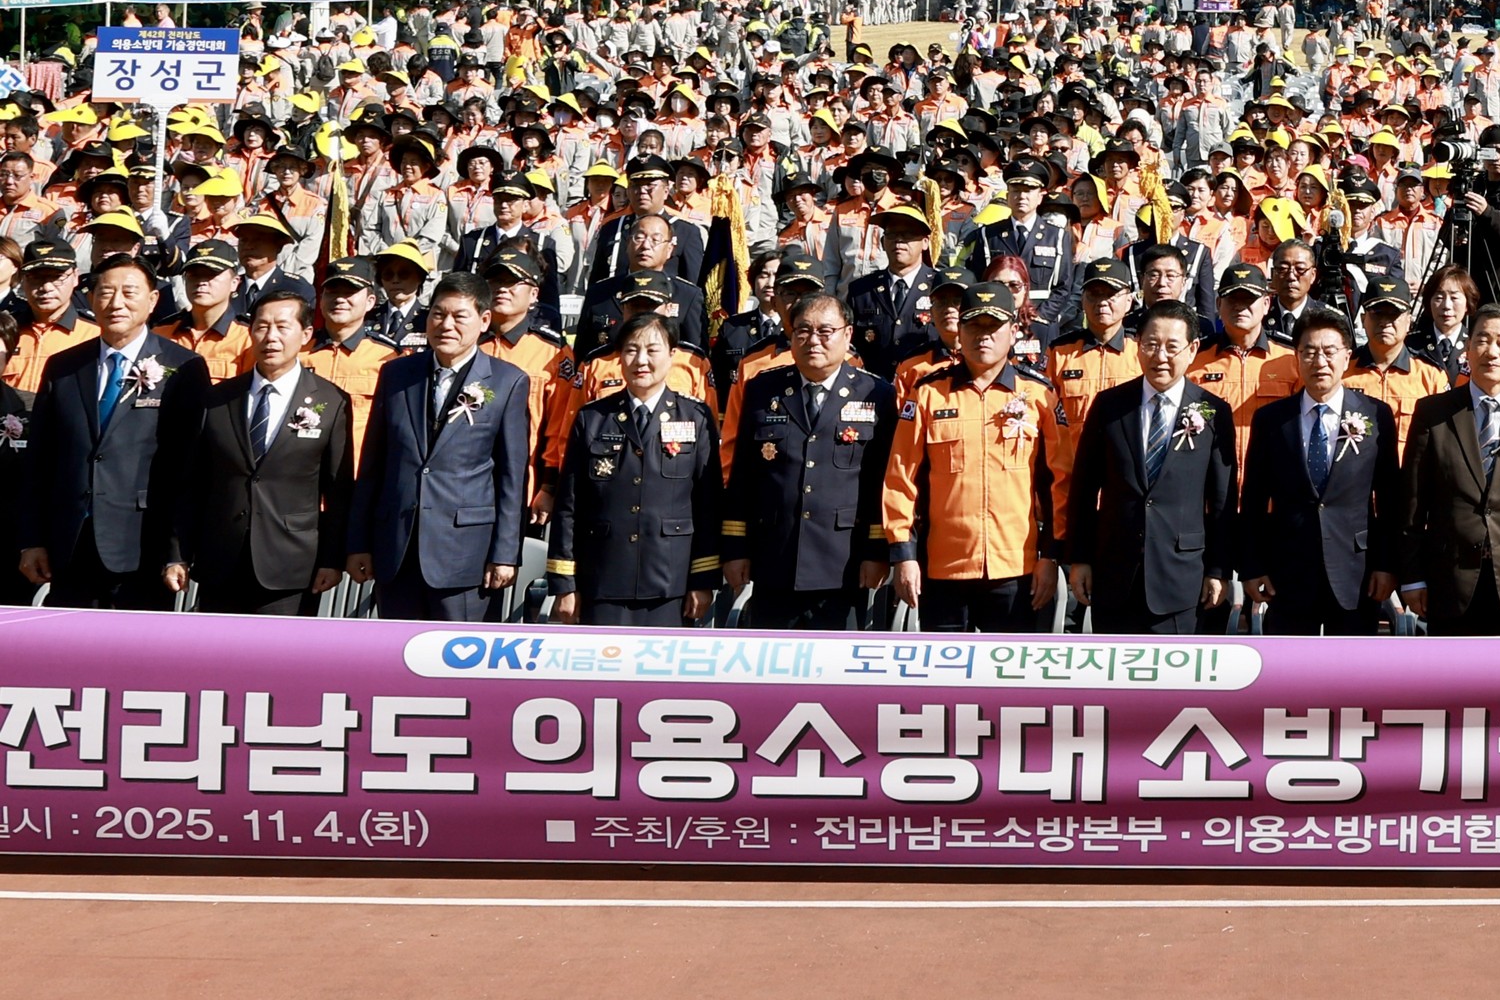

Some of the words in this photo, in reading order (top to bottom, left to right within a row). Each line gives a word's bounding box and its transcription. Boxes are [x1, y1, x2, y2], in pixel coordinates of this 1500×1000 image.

[112, 39, 162, 50] 의용소방대
[165, 40, 226, 51] 기술경연대회
[138, 30, 166, 39] 제42회
[168, 31, 201, 39] 전라남도
[107, 59, 225, 91] 장성군
[441, 636, 542, 671] OK!
[545, 645, 622, 674] 지금은
[633, 638, 824, 678] 전남시대,
[844, 645, 976, 679] 도민의
[989, 646, 1220, 684] 안전지킴이!
[0, 686, 478, 794] 전라남도
[505, 697, 1107, 803] 의용소방대
[95, 806, 228, 843] 2025.
[242, 810, 302, 843] 11.
[313, 809, 430, 847] 4.(화)
[590, 814, 772, 850] 주최/후원
[813, 815, 1168, 852] 전라남도소방본부
